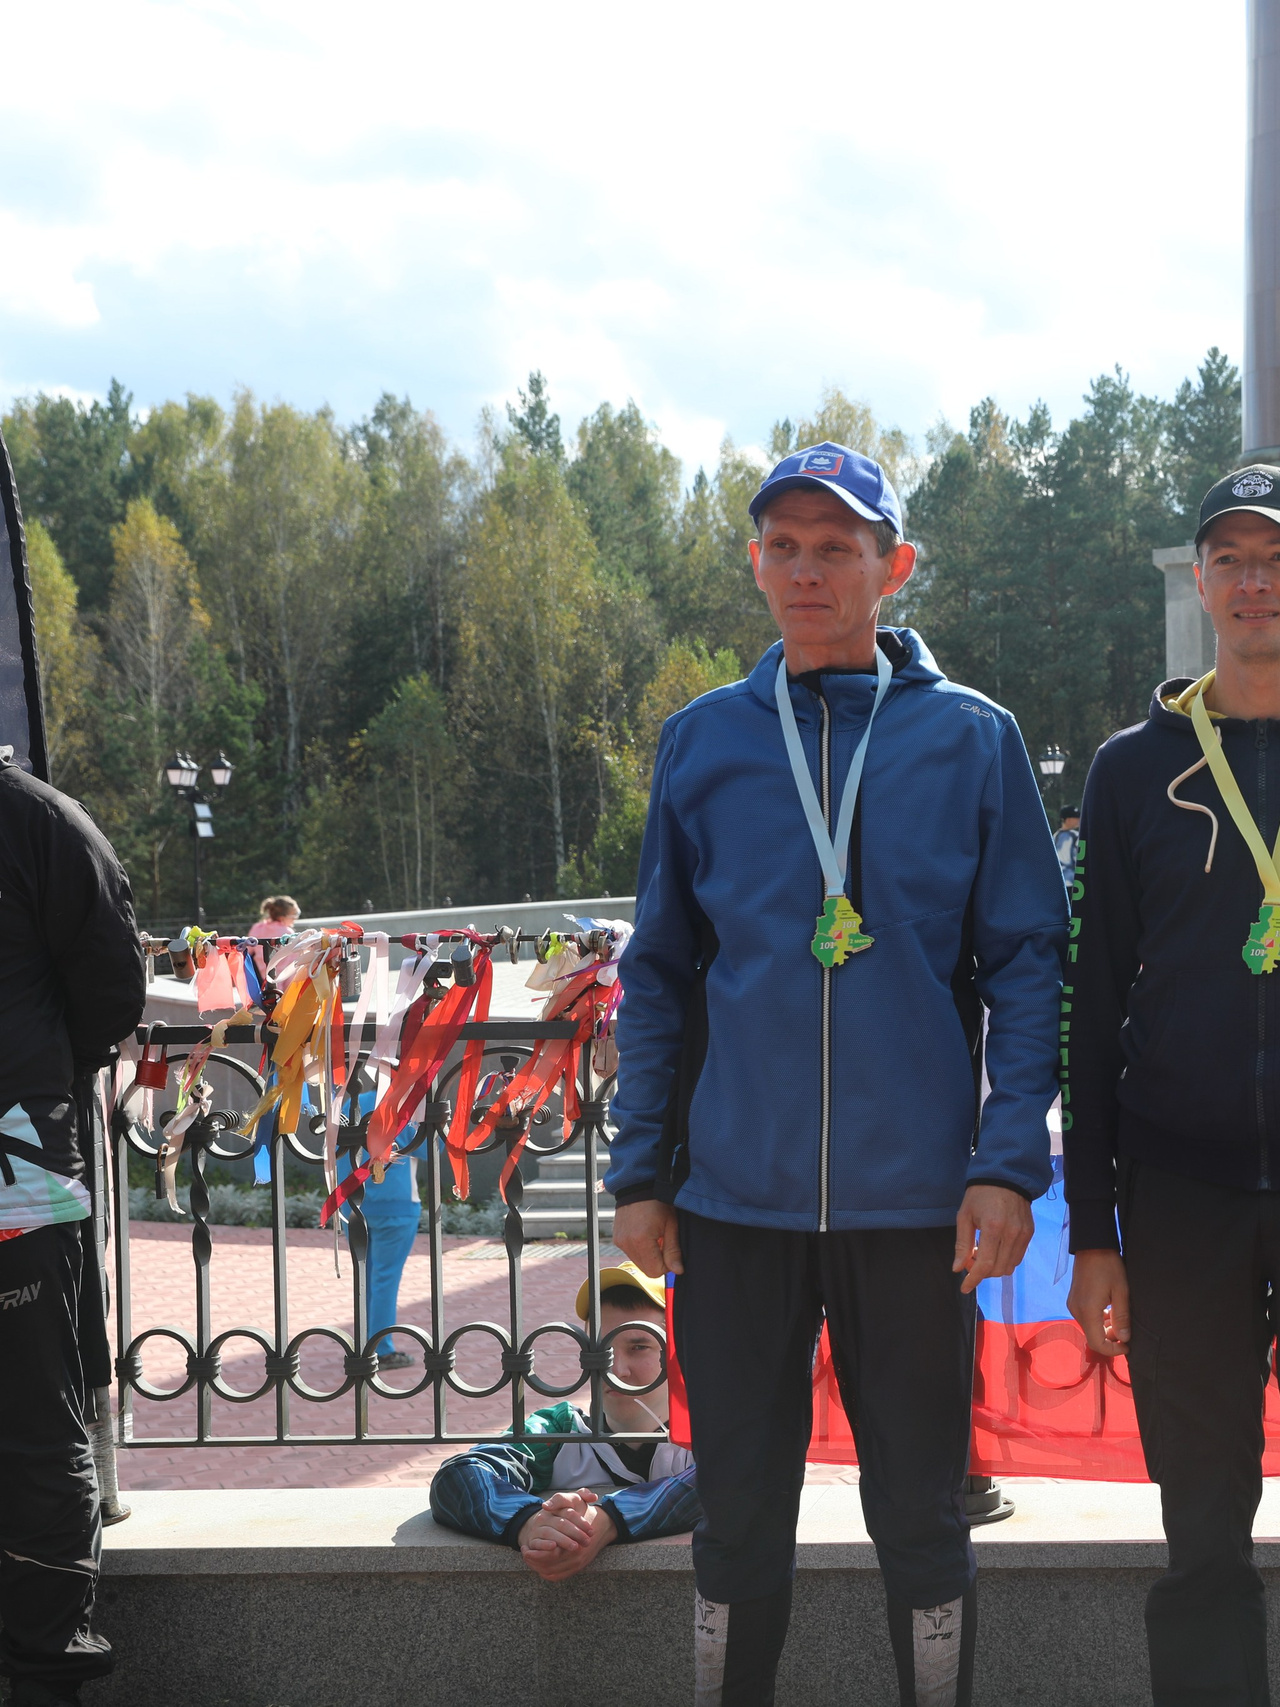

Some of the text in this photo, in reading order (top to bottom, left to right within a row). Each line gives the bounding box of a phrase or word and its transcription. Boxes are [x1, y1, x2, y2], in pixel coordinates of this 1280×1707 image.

[960, 702, 990, 718] CMP
[842, 920, 857, 929] 101
[819, 941, 835, 950] 101
[1249, 948, 1265, 956] 101
